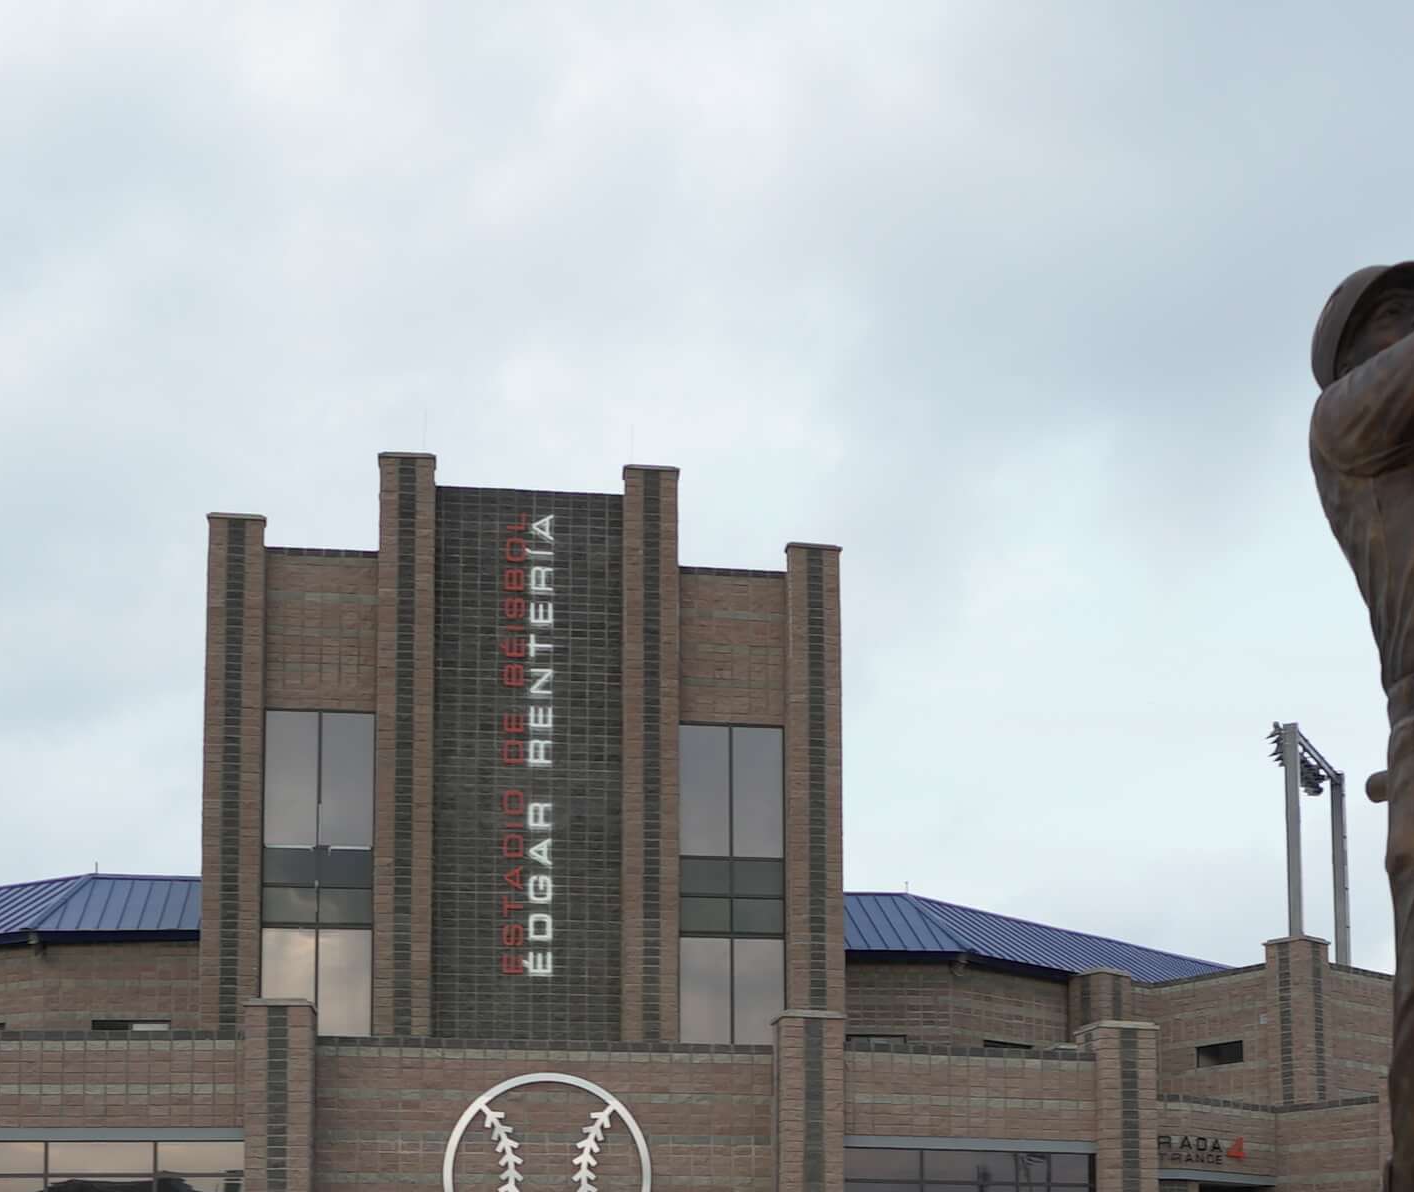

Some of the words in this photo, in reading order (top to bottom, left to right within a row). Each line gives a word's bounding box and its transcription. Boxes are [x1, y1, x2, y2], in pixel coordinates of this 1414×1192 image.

[501, 512, 528, 687] BÉISBOL
[525, 514, 554, 767] RENTERÍA
[503, 711, 524, 766] DE
[502, 789, 524, 975] ESTADIO
[523, 802, 553, 977] ÉDGAR
[1158, 1135, 1223, 1152] RADA
[1226, 1135, 1245, 1159] 4
[1158, 1152, 1223, 1166] TRANCE
